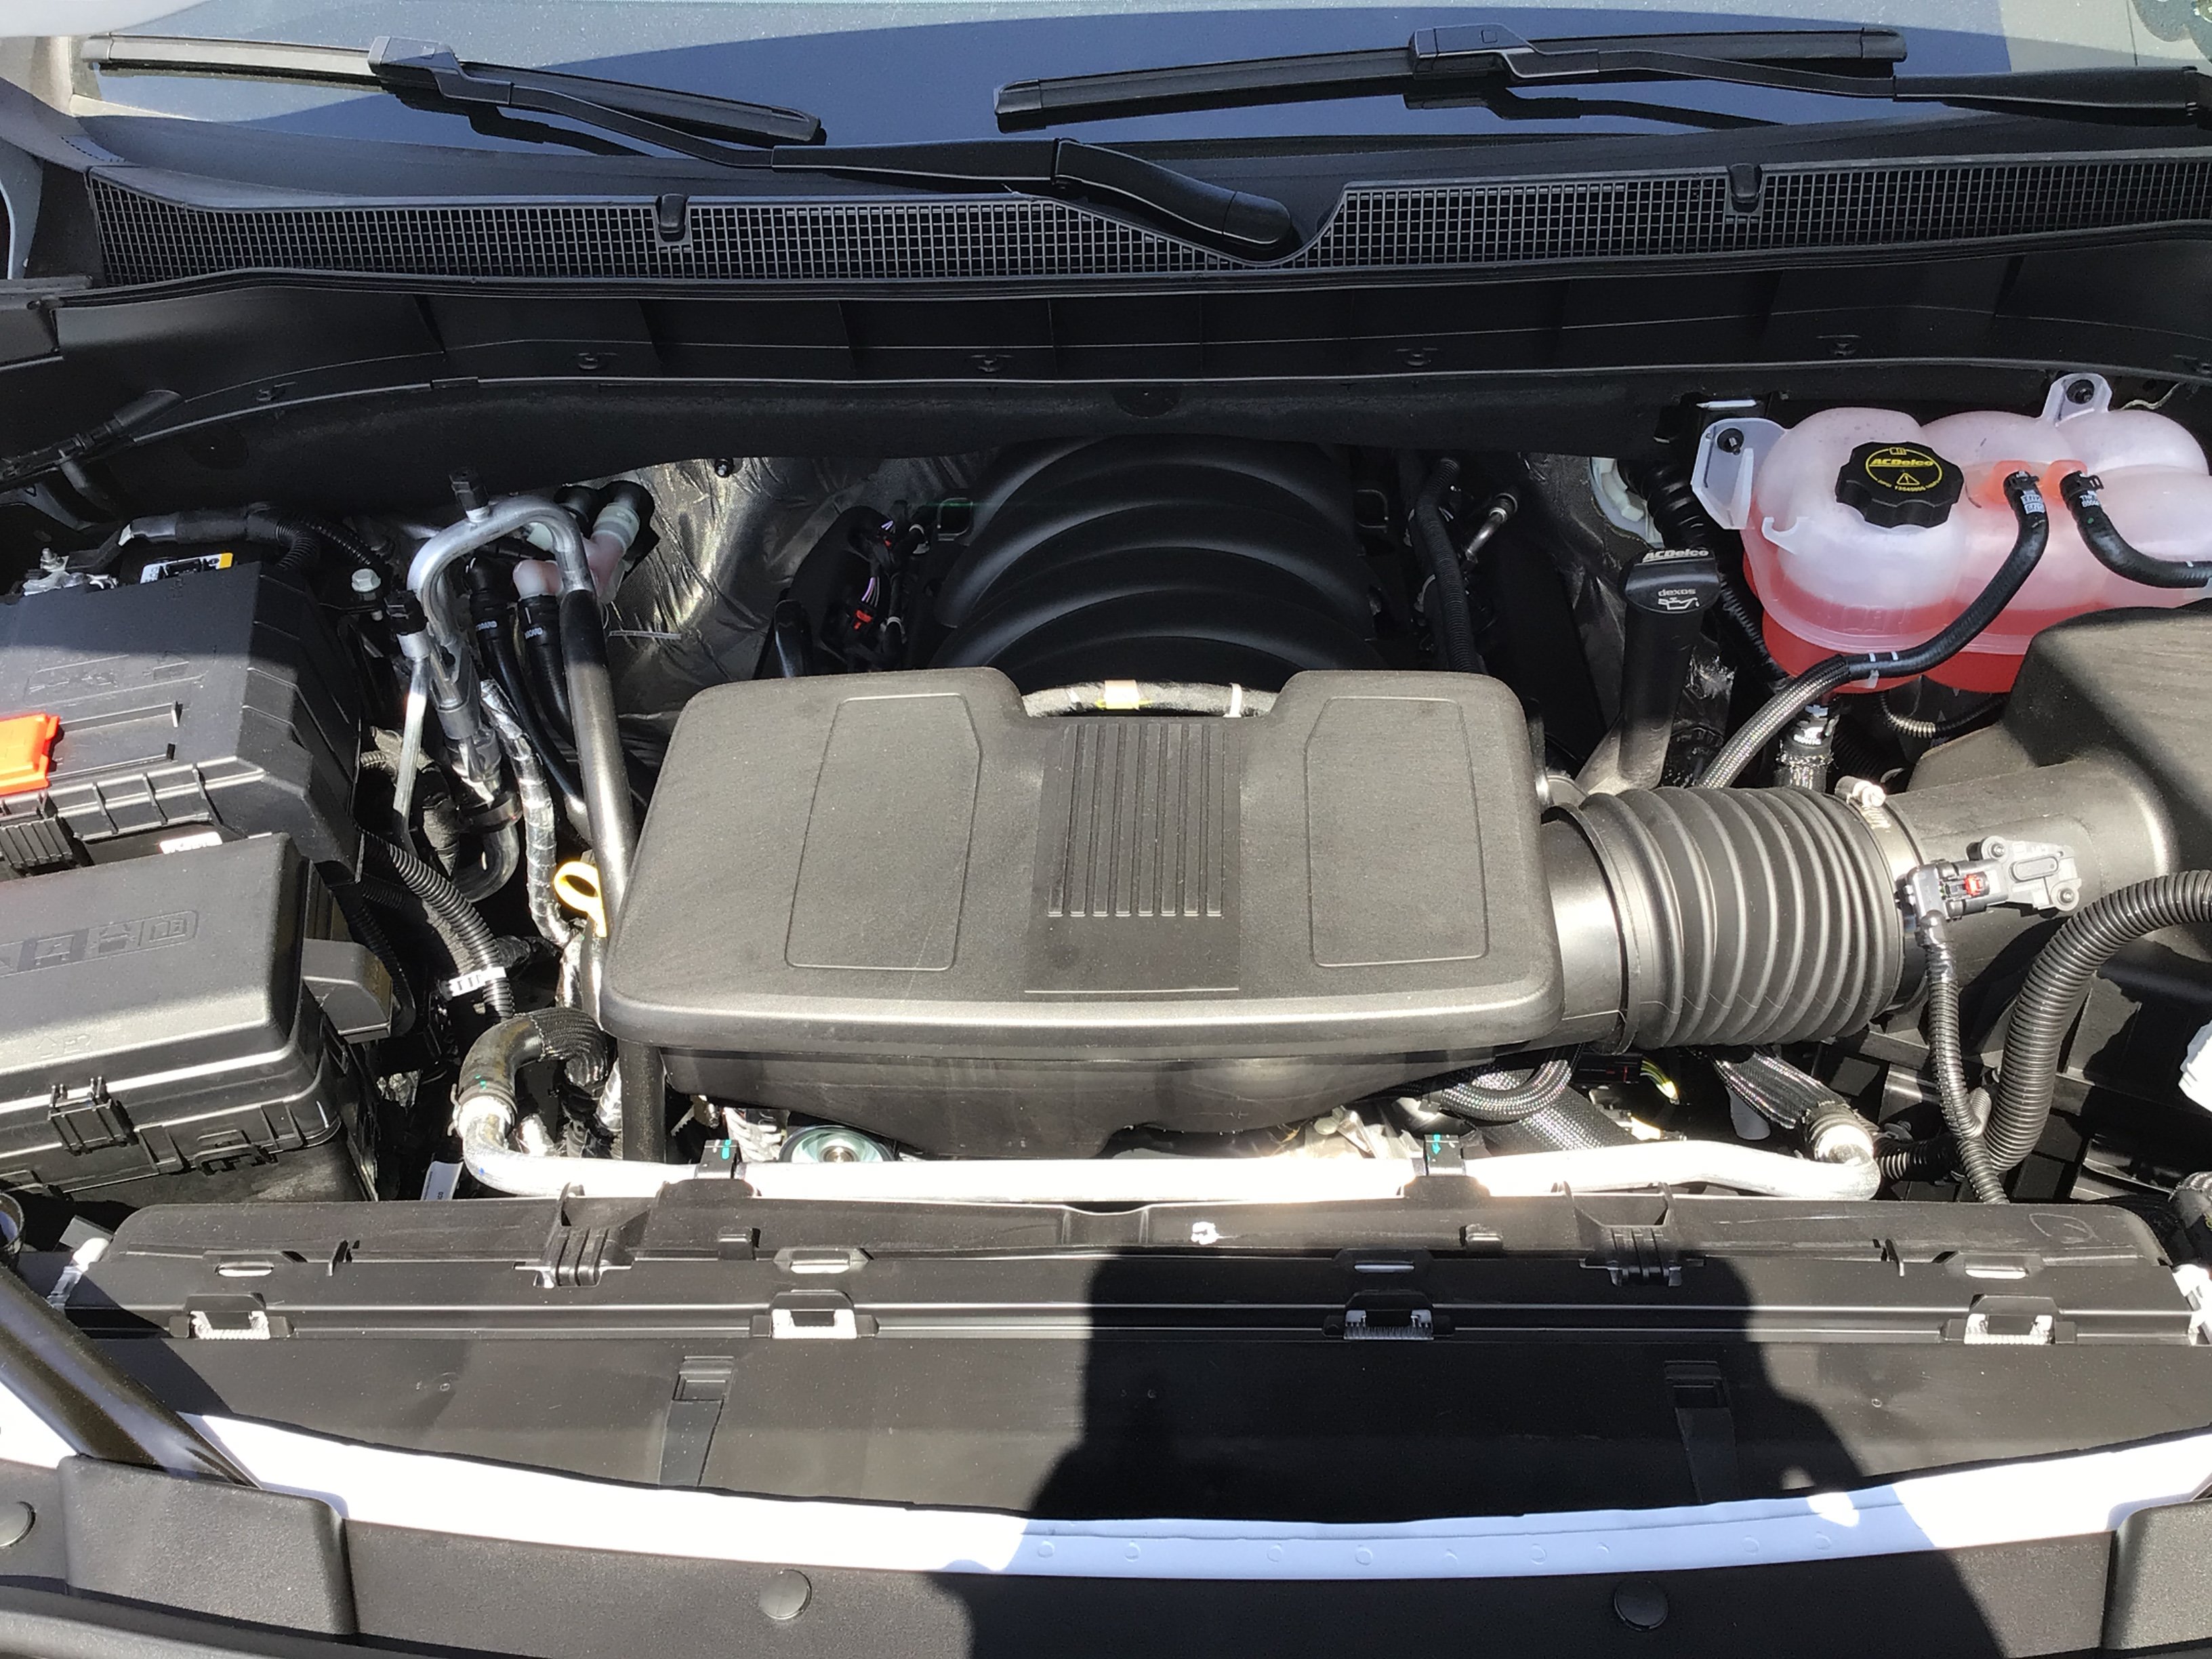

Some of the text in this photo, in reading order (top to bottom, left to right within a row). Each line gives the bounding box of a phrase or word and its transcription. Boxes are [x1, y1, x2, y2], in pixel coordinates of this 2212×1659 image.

[1870, 458, 1934, 467] ACDelco
[1642, 548, 1709, 563] ACDelco
[1658, 588, 1696, 596] dexos
